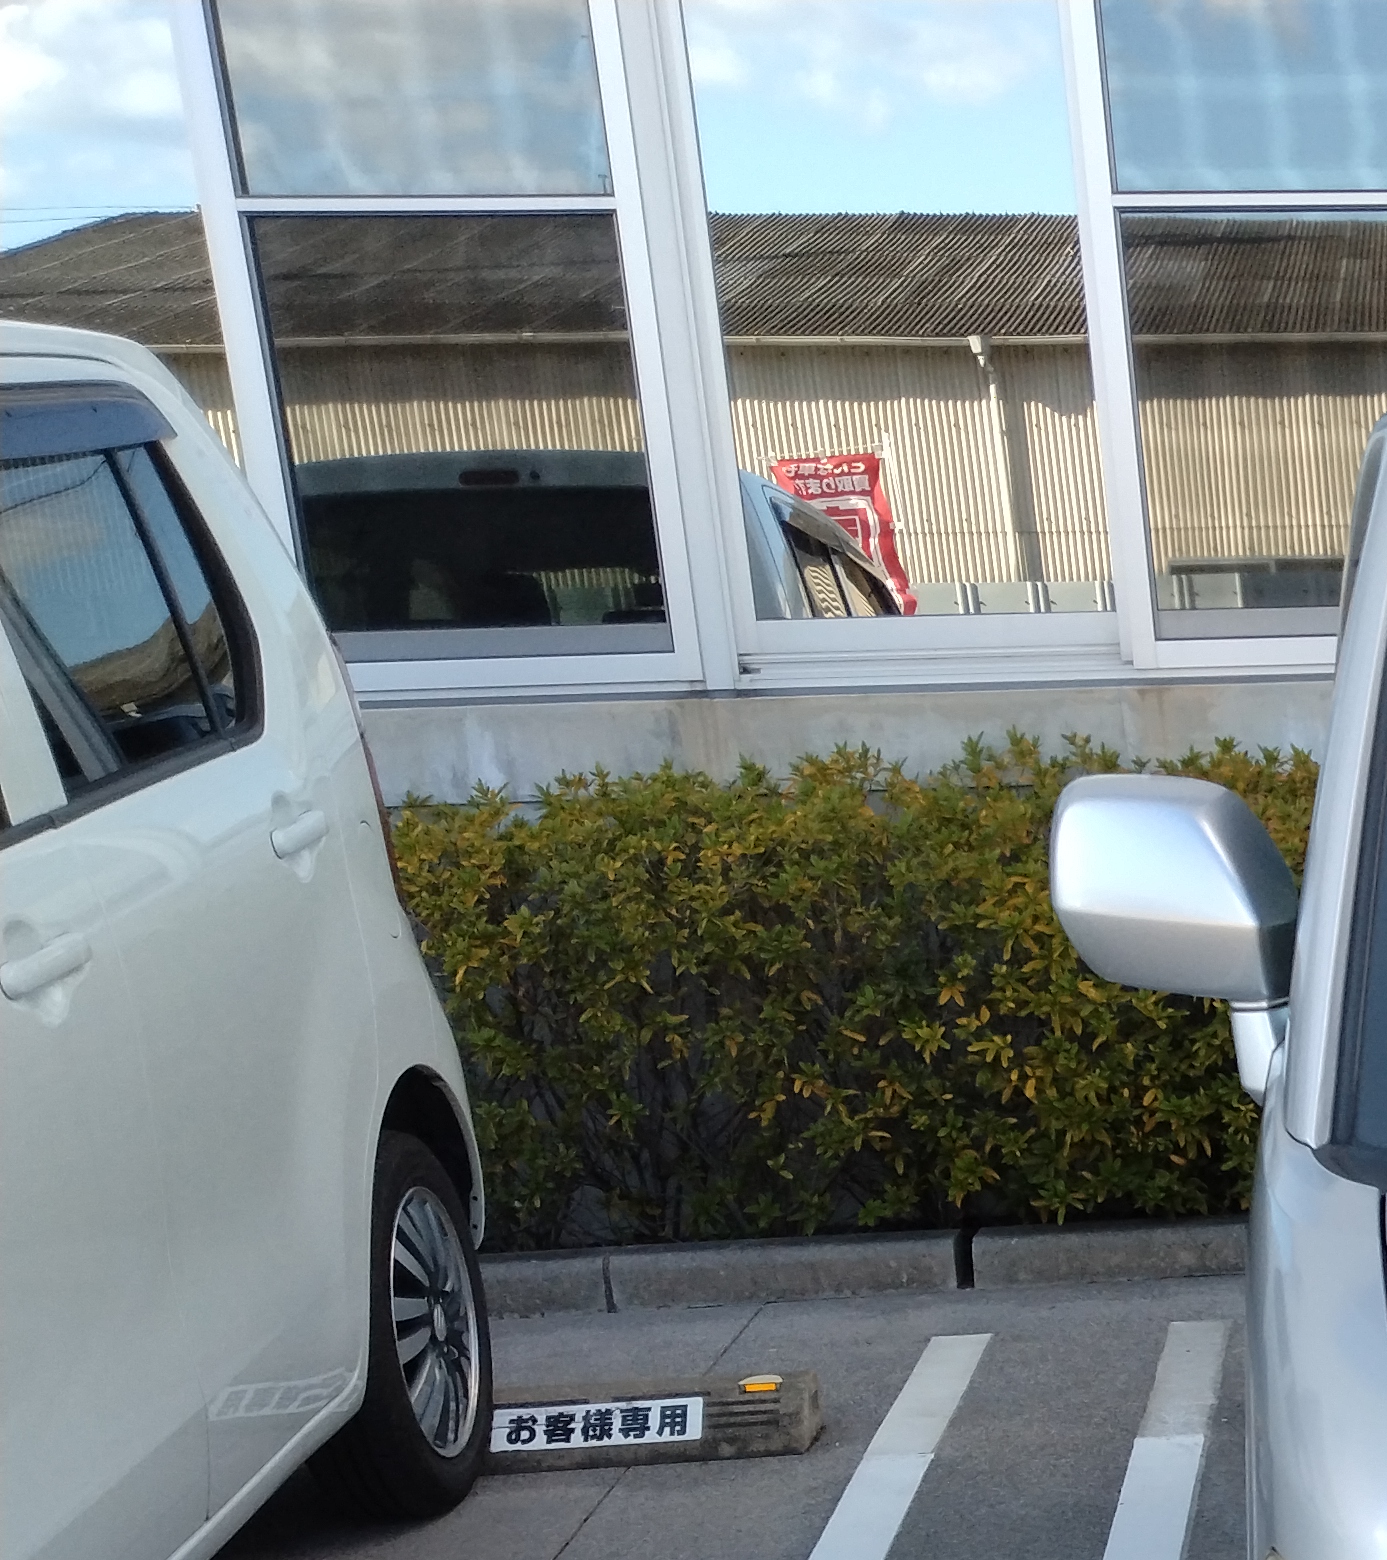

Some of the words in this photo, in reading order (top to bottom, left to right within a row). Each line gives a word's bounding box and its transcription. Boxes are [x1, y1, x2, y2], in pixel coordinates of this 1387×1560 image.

[506, 1403, 688, 1445] お客様専用
